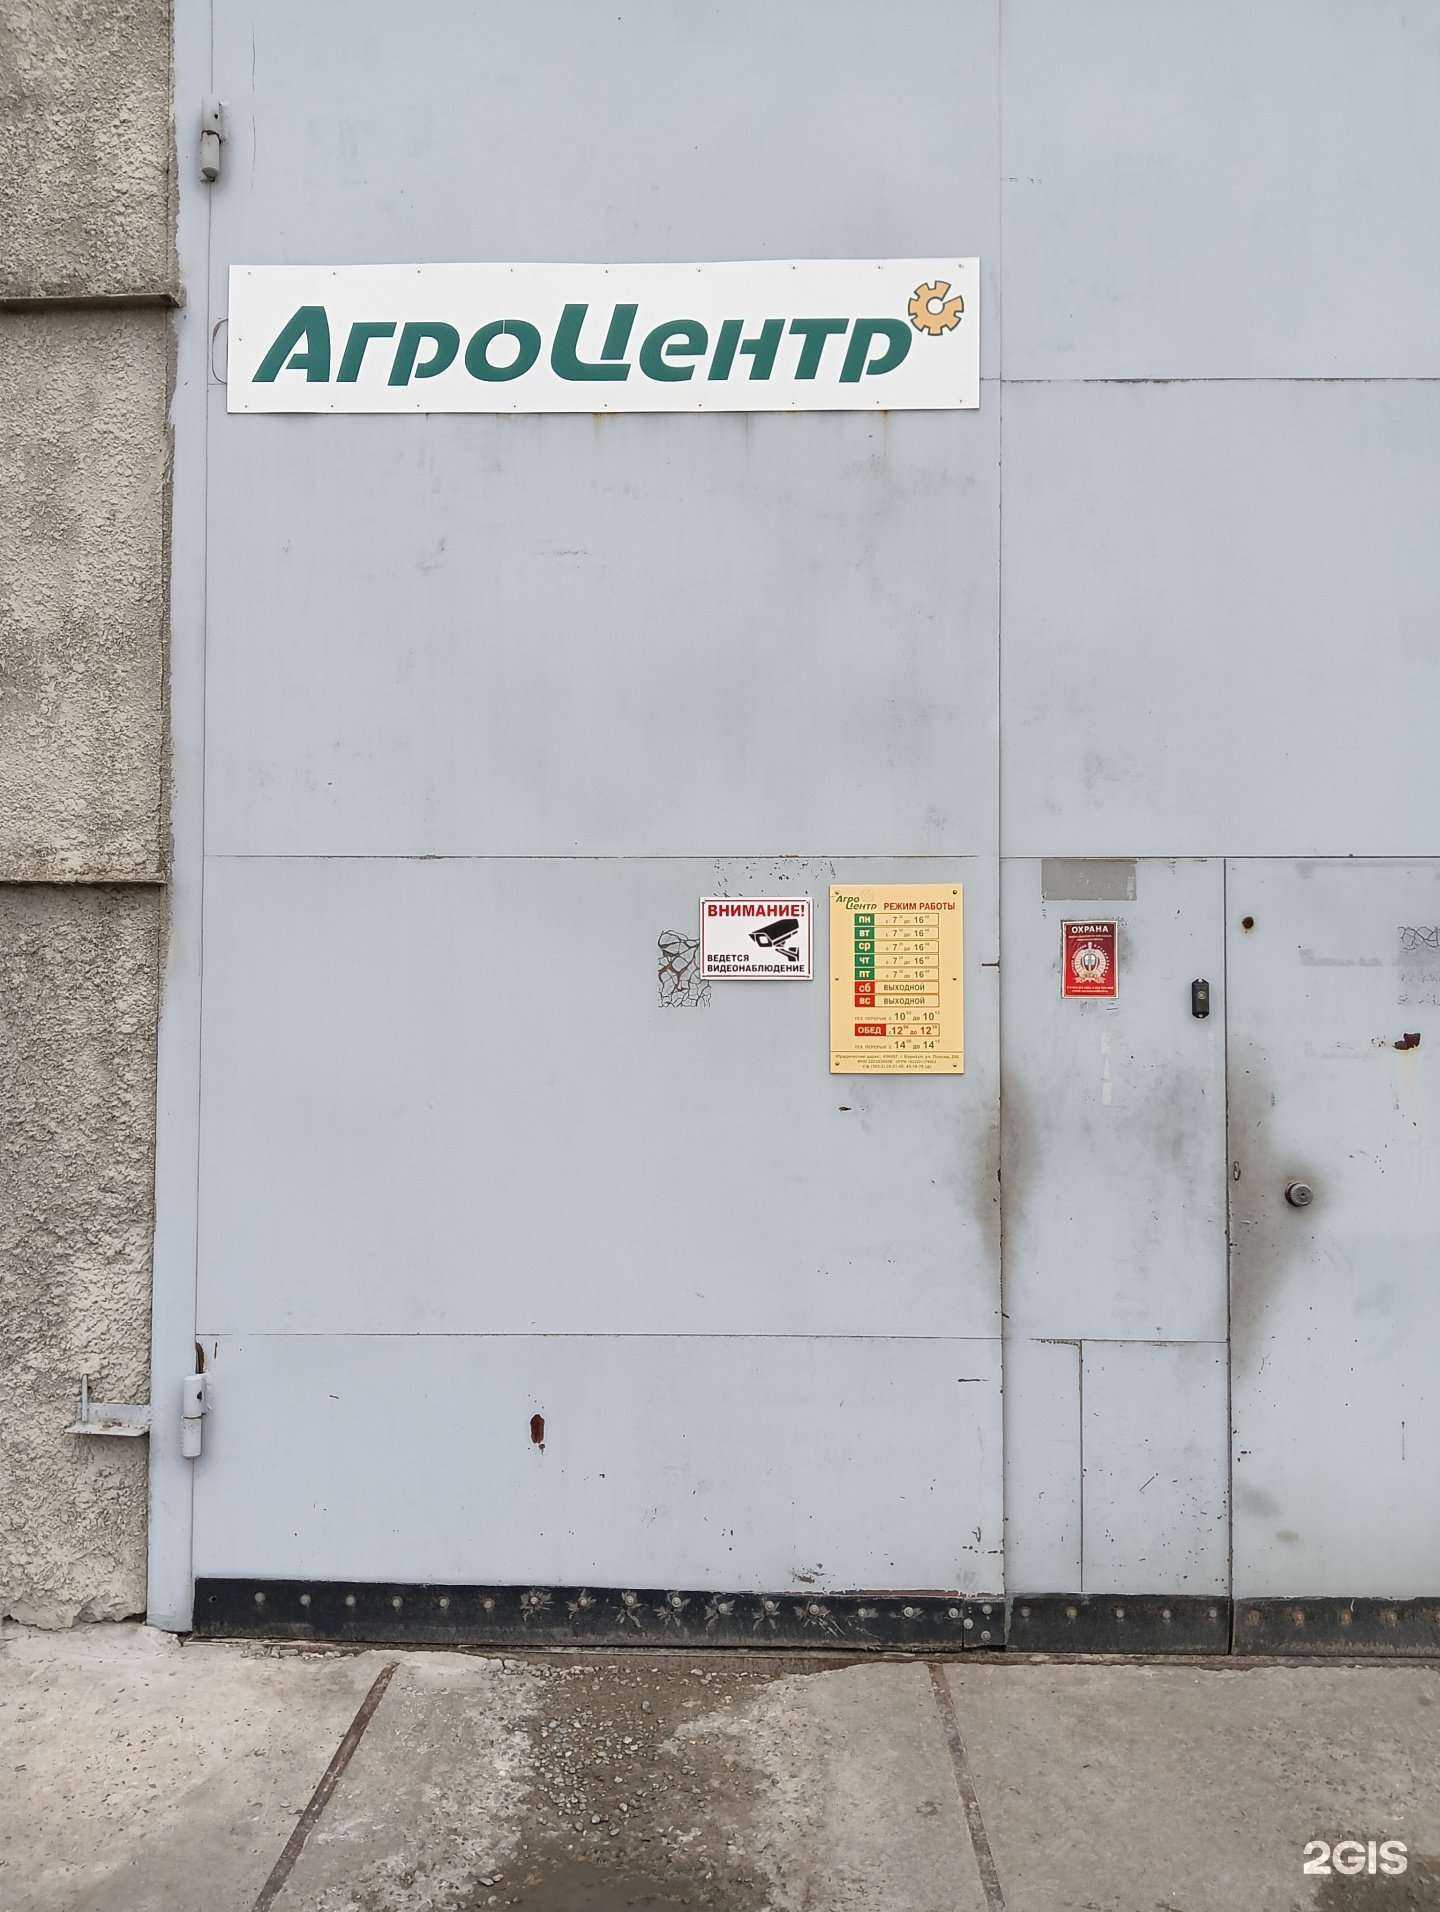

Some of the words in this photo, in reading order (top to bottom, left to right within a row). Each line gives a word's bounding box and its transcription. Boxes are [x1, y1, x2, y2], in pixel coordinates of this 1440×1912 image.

[251, 303, 912, 386] АгроЦентр
[707, 904, 805, 917] ВНИМАНИЕ!
[883, 902, 917, 911] РЕЖИМ
[919, 902, 955, 910] РАБОТЫ
[1071, 925, 1109, 934] ОХРАНА
[707, 954, 749, 963] ВЕДЕТСЯ
[707, 964, 805, 974] ВИДЕОНАБЛЮДЕНИЕ
[857, 1026, 882, 1035] ОБЕД
